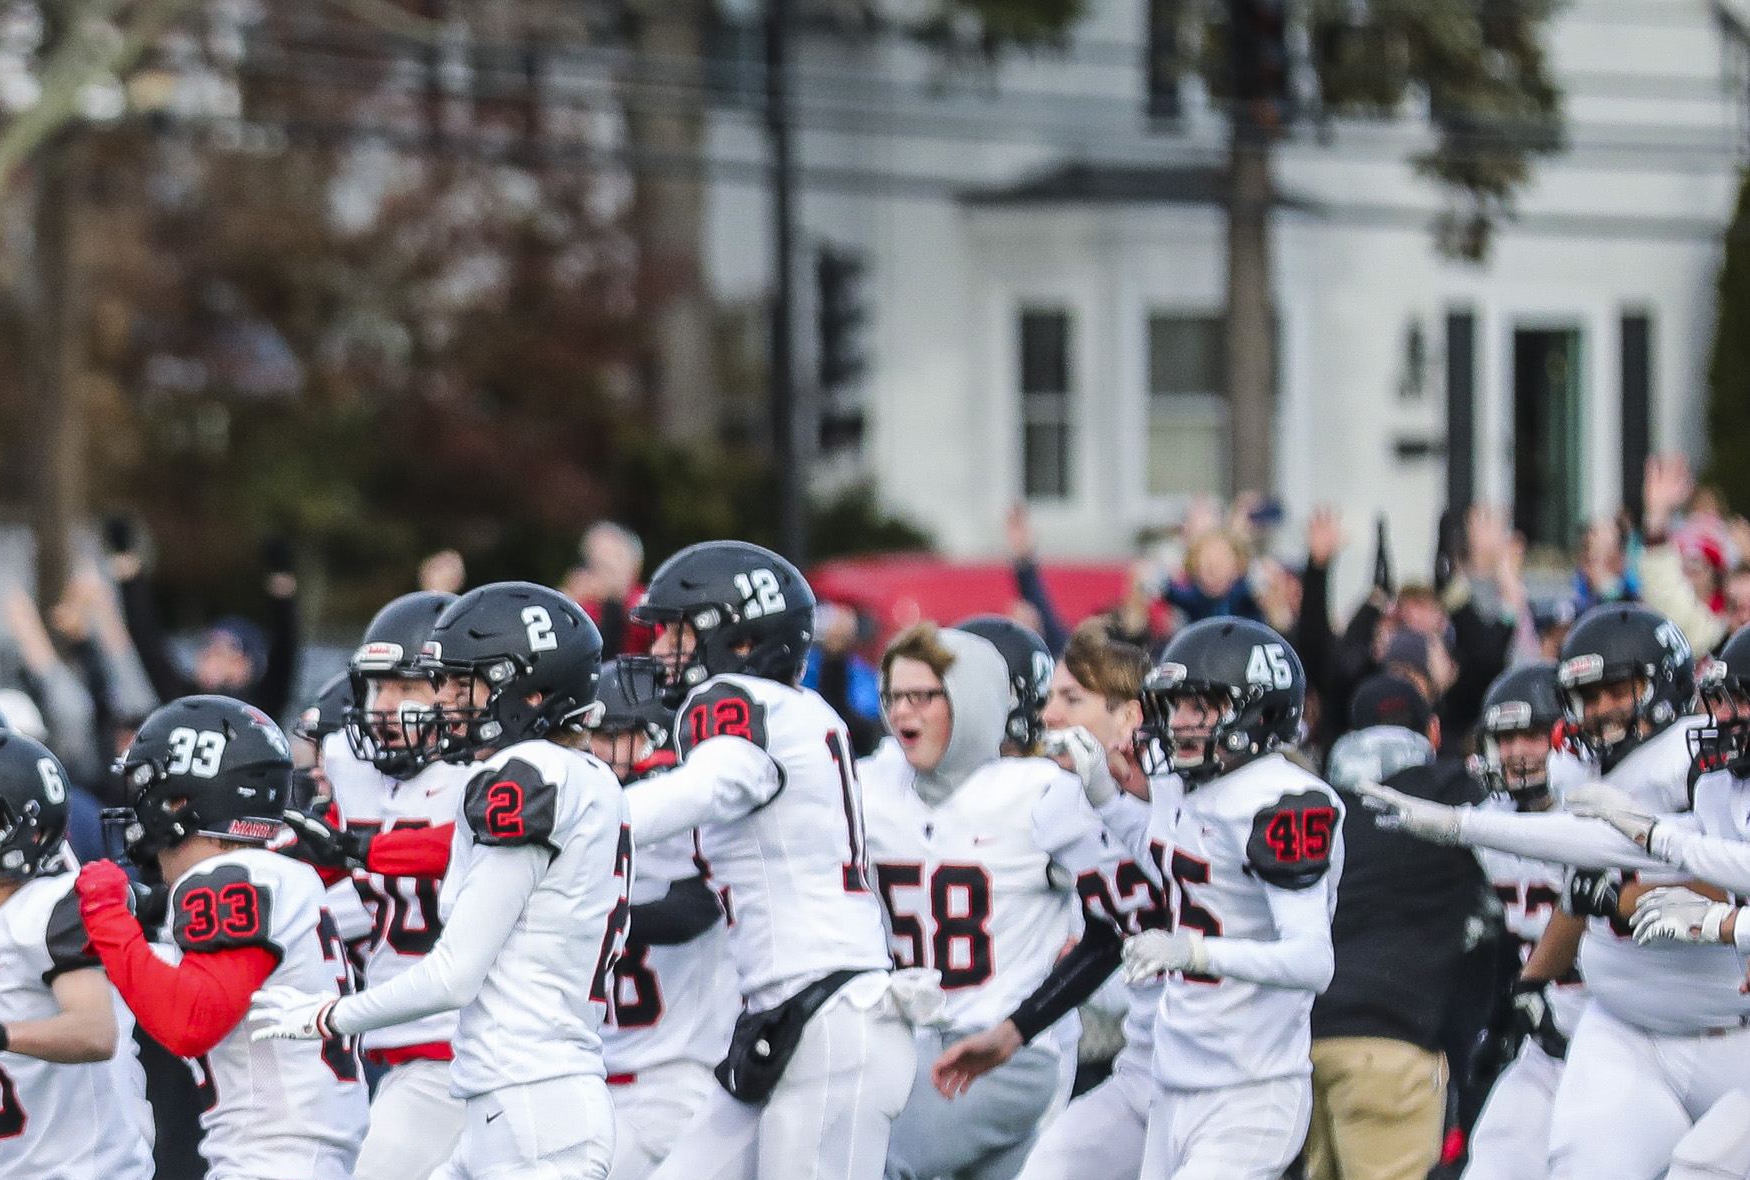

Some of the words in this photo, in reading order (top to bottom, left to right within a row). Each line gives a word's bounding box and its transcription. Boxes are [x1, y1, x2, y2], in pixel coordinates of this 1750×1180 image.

[733, 568, 787, 620] 12
[521, 605, 558, 652] 2
[1246, 643, 1292, 690] 45
[168, 726, 226, 779] 33
[37, 758, 66, 804] 6
[486, 781, 524, 837] 2
[1266, 807, 1335, 862] 45
[181, 881, 260, 942] 33
[875, 862, 995, 990] 58
